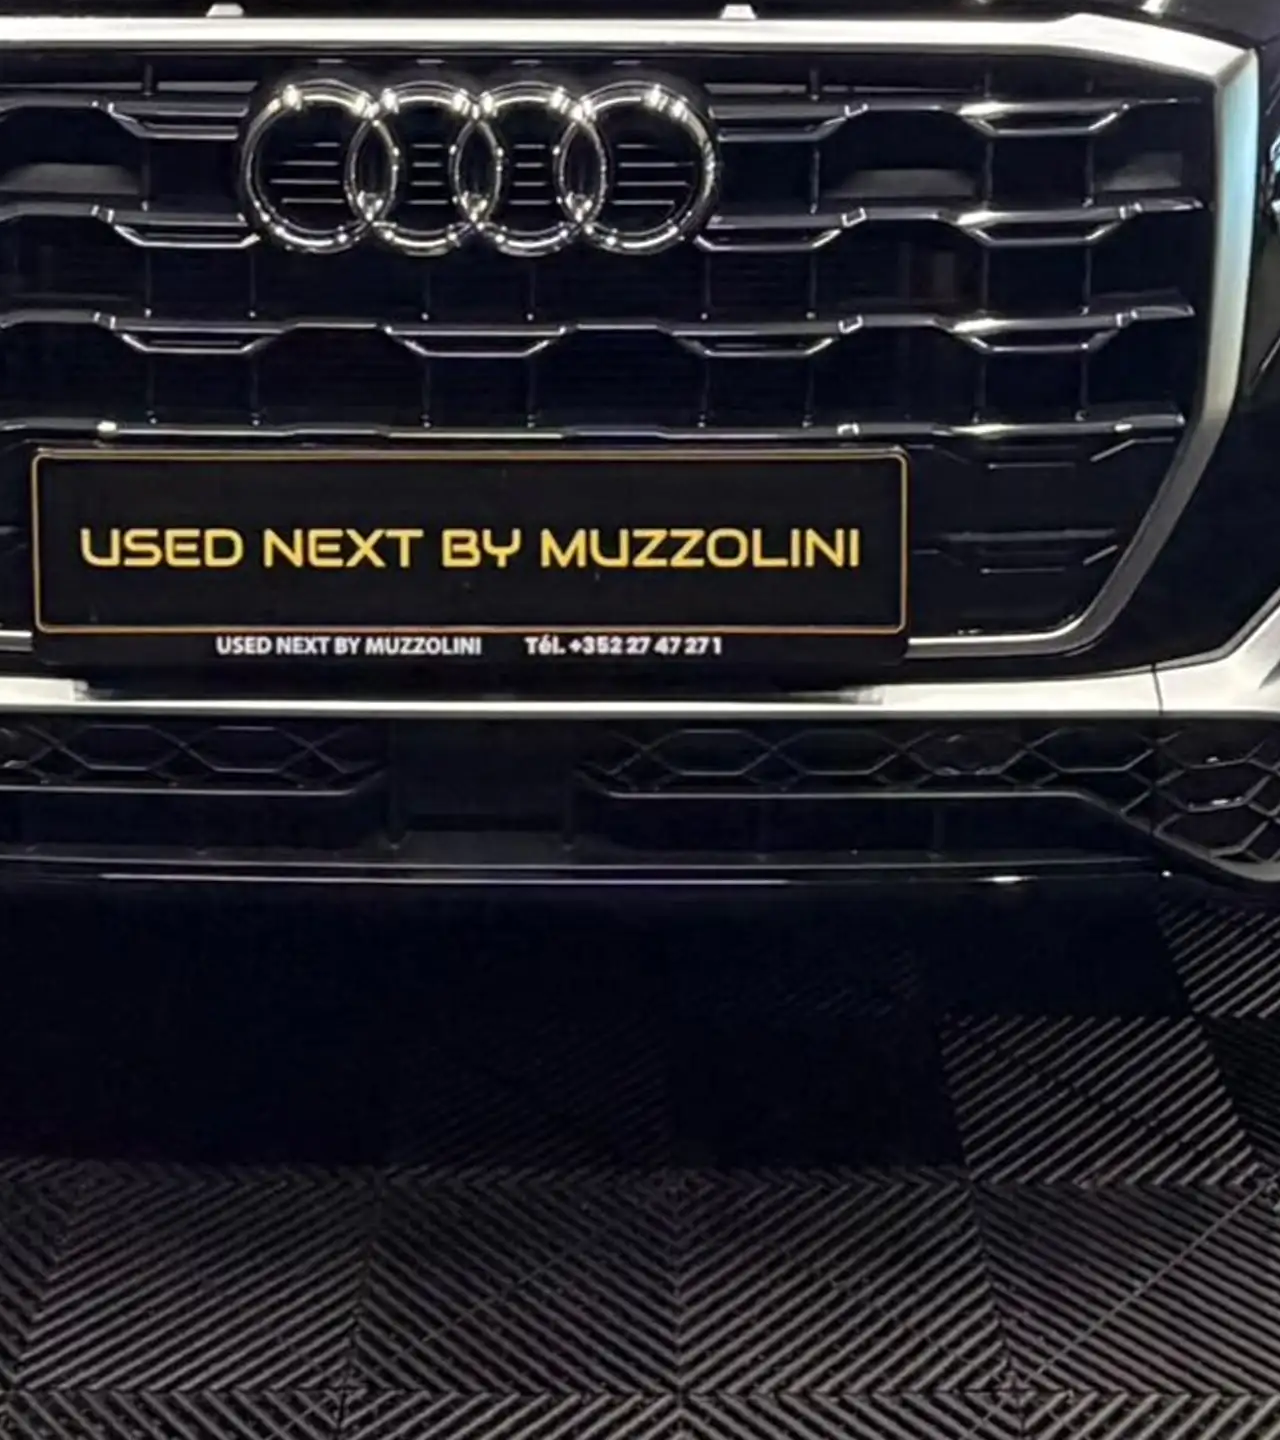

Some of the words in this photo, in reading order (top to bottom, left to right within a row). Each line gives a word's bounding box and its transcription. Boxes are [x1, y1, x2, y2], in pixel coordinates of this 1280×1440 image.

[80, 528, 244, 567] USED
[263, 528, 424, 567] NEXT
[442, 528, 521, 567] BY
[540, 528, 859, 567] MUZZOLINI
[216, 635, 273, 654] USED
[275, 635, 331, 654] NEXT
[333, 635, 362, 654] BY
[364, 635, 482, 654] MUZZOLINI
[568, 635, 623, 655] +352
[625, 635, 652, 655] 27
[654, 635, 682, 655] 47
